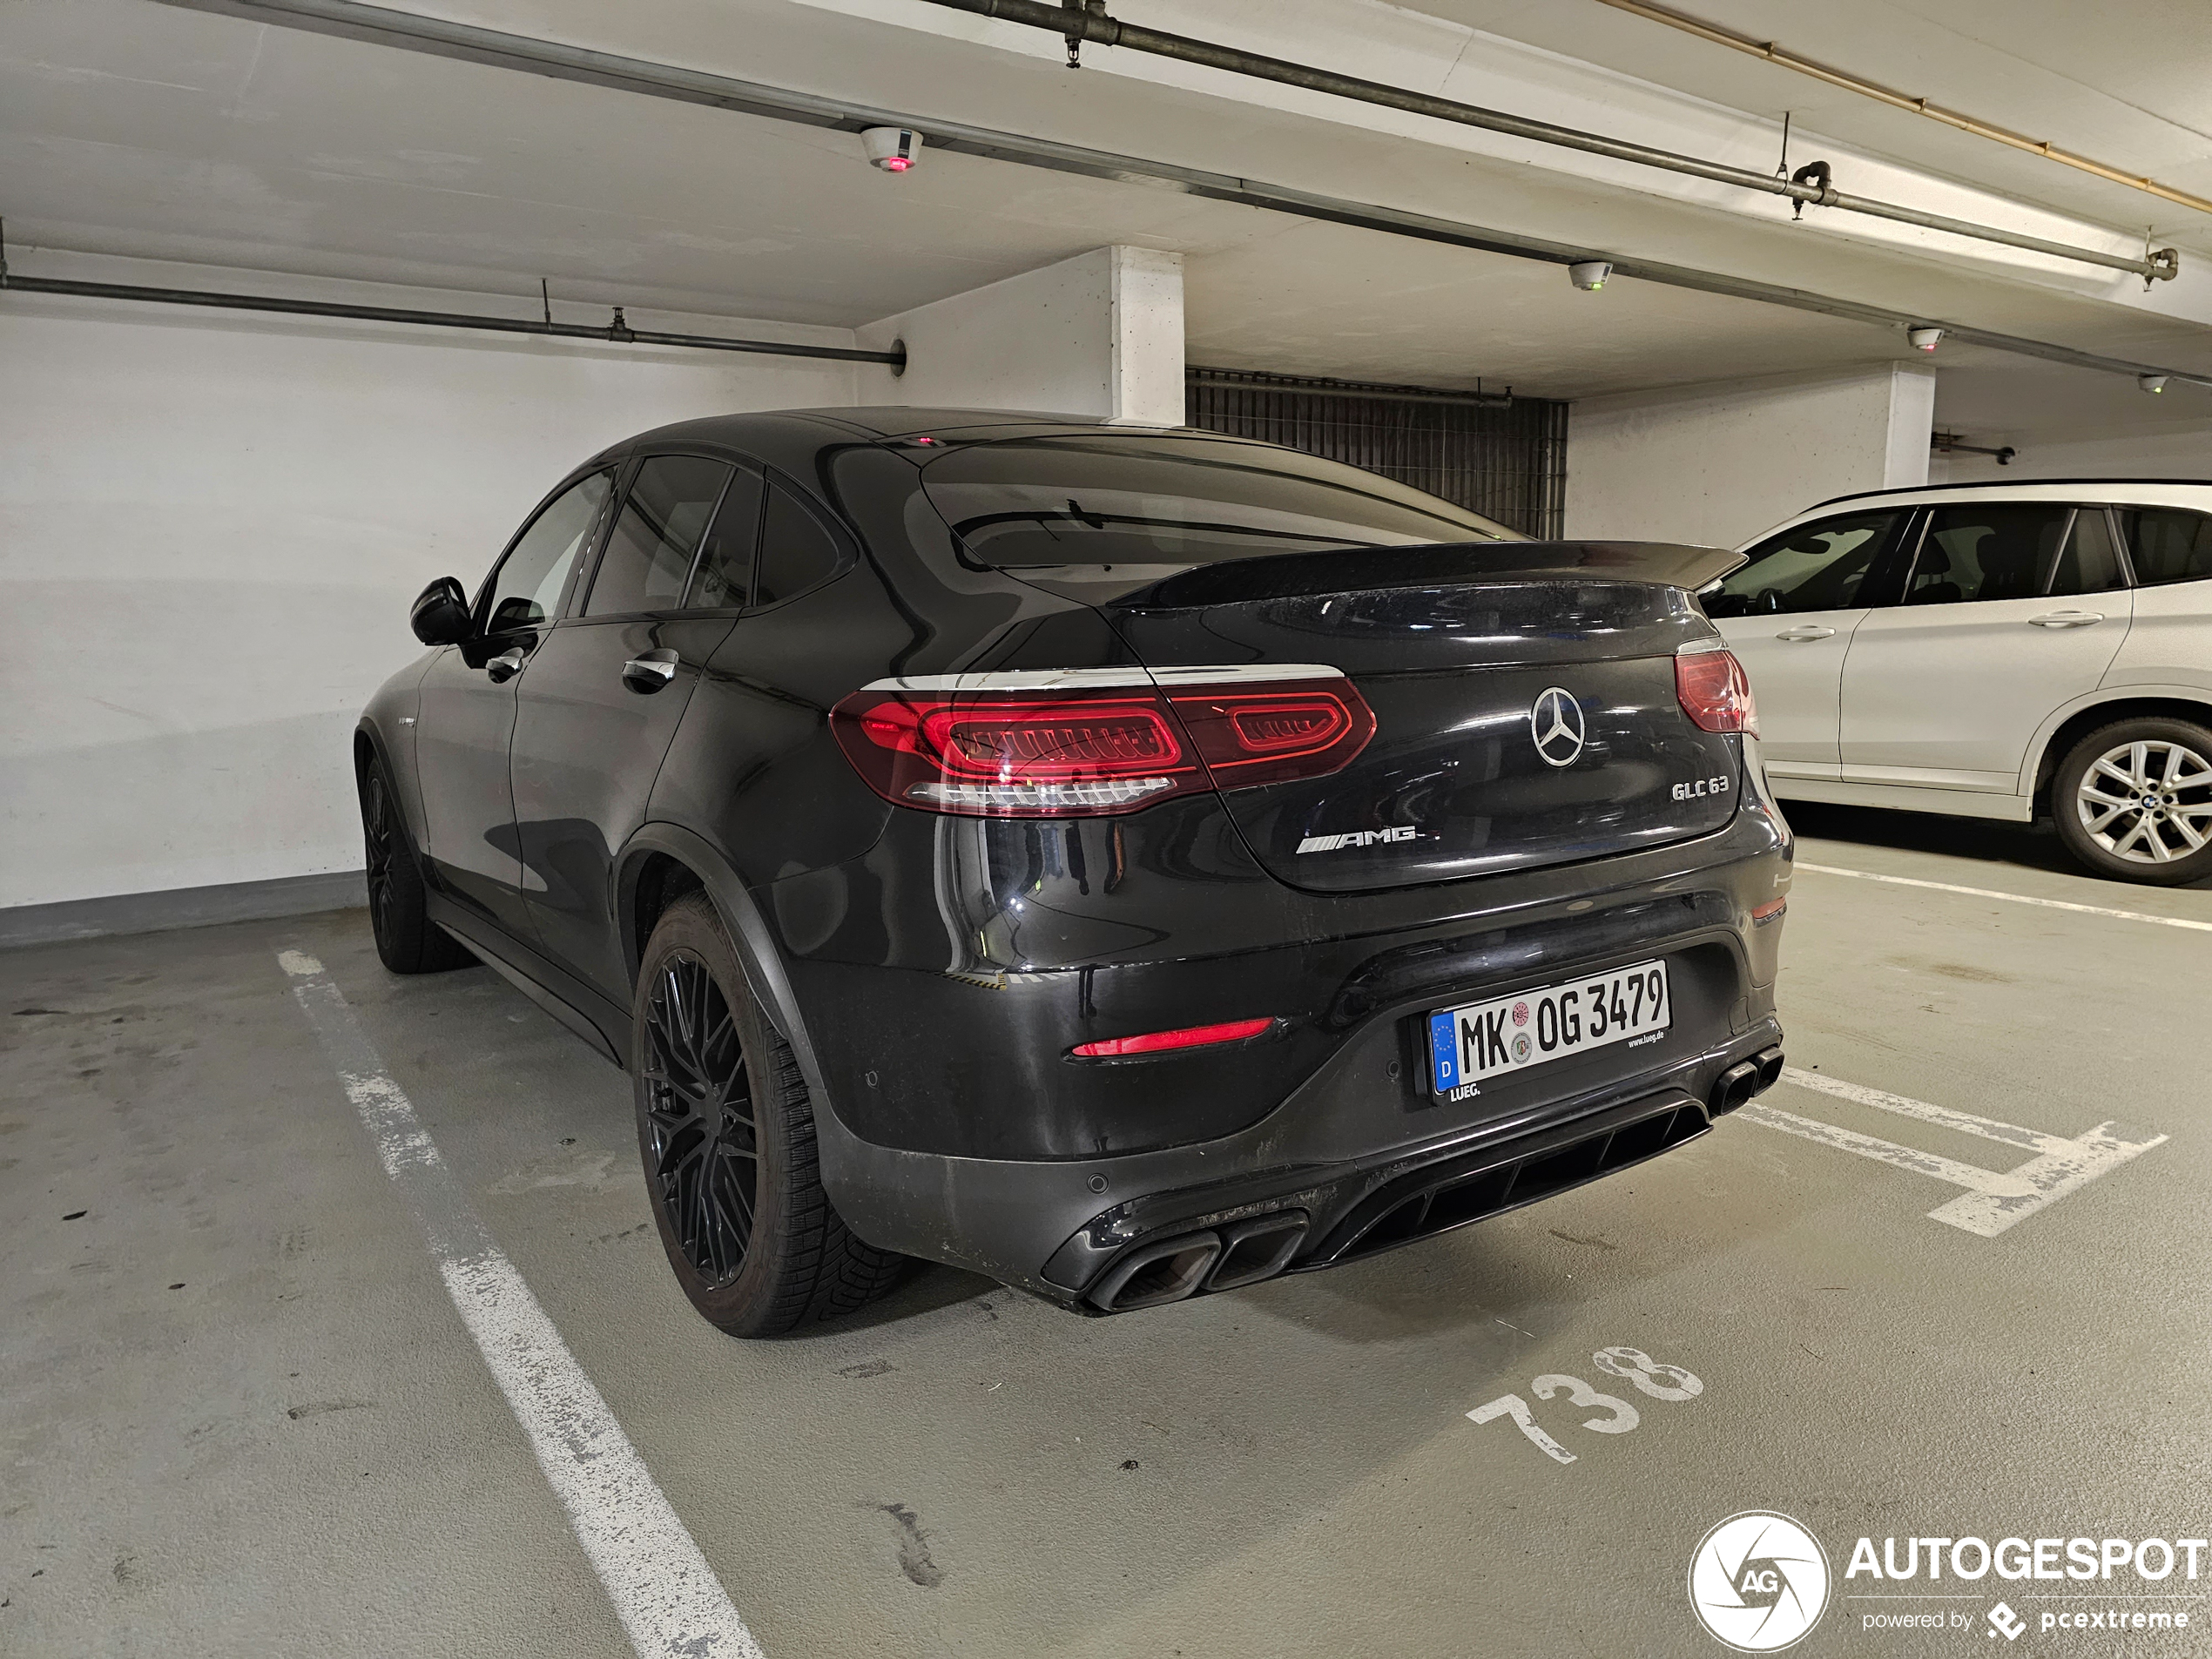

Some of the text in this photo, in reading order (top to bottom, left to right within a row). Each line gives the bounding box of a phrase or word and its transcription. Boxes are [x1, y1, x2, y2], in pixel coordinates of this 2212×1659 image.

[1672, 775, 1730, 800] GLC 63
[1335, 826, 1416, 850] AMG
[1461, 1008, 1509, 1074] MK
[1537, 991, 1581, 1051] OG
[1587, 969, 1664, 1037] 3479
[1629, 1030, 1664, 1048] www.lueg.de
[1441, 1061, 1451, 1078] D
[1450, 1082, 1480, 1103] LUEG.
[1465, 1347, 1703, 1465] 738
